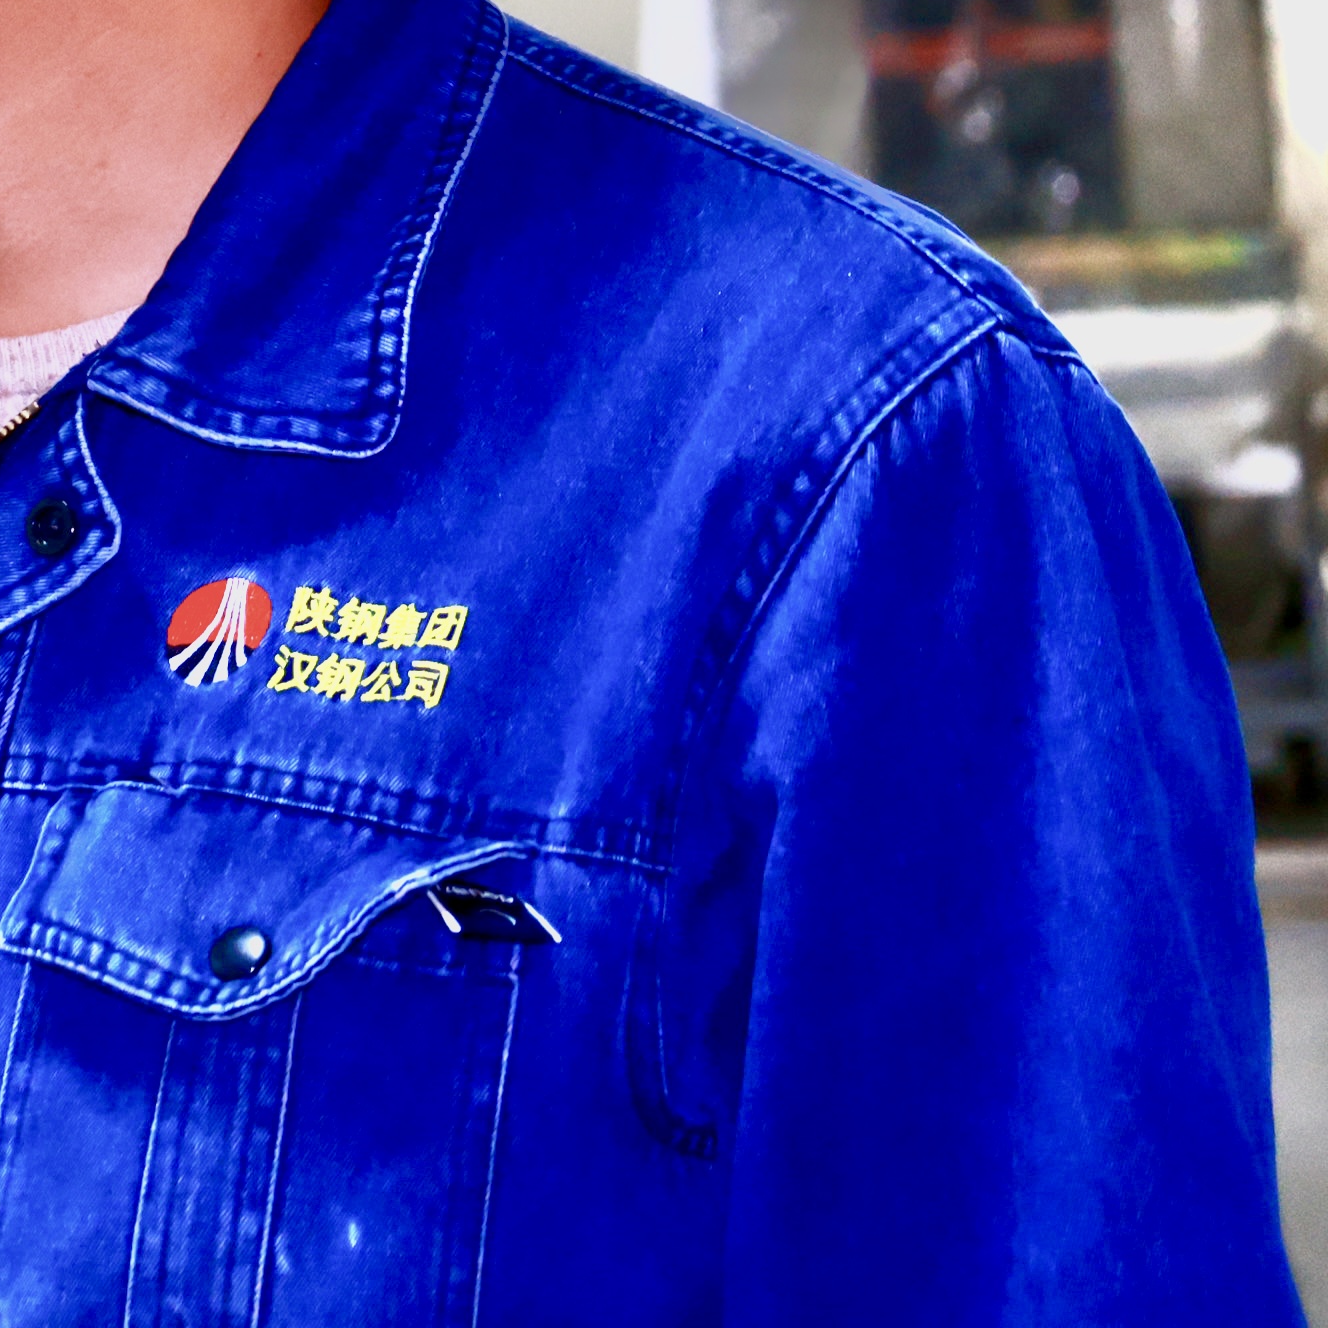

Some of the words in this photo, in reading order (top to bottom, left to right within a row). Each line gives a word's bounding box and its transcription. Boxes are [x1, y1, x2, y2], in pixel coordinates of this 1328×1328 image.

[285, 586, 468, 651] 陕钢集团
[267, 644, 450, 709] 汉钢公司
